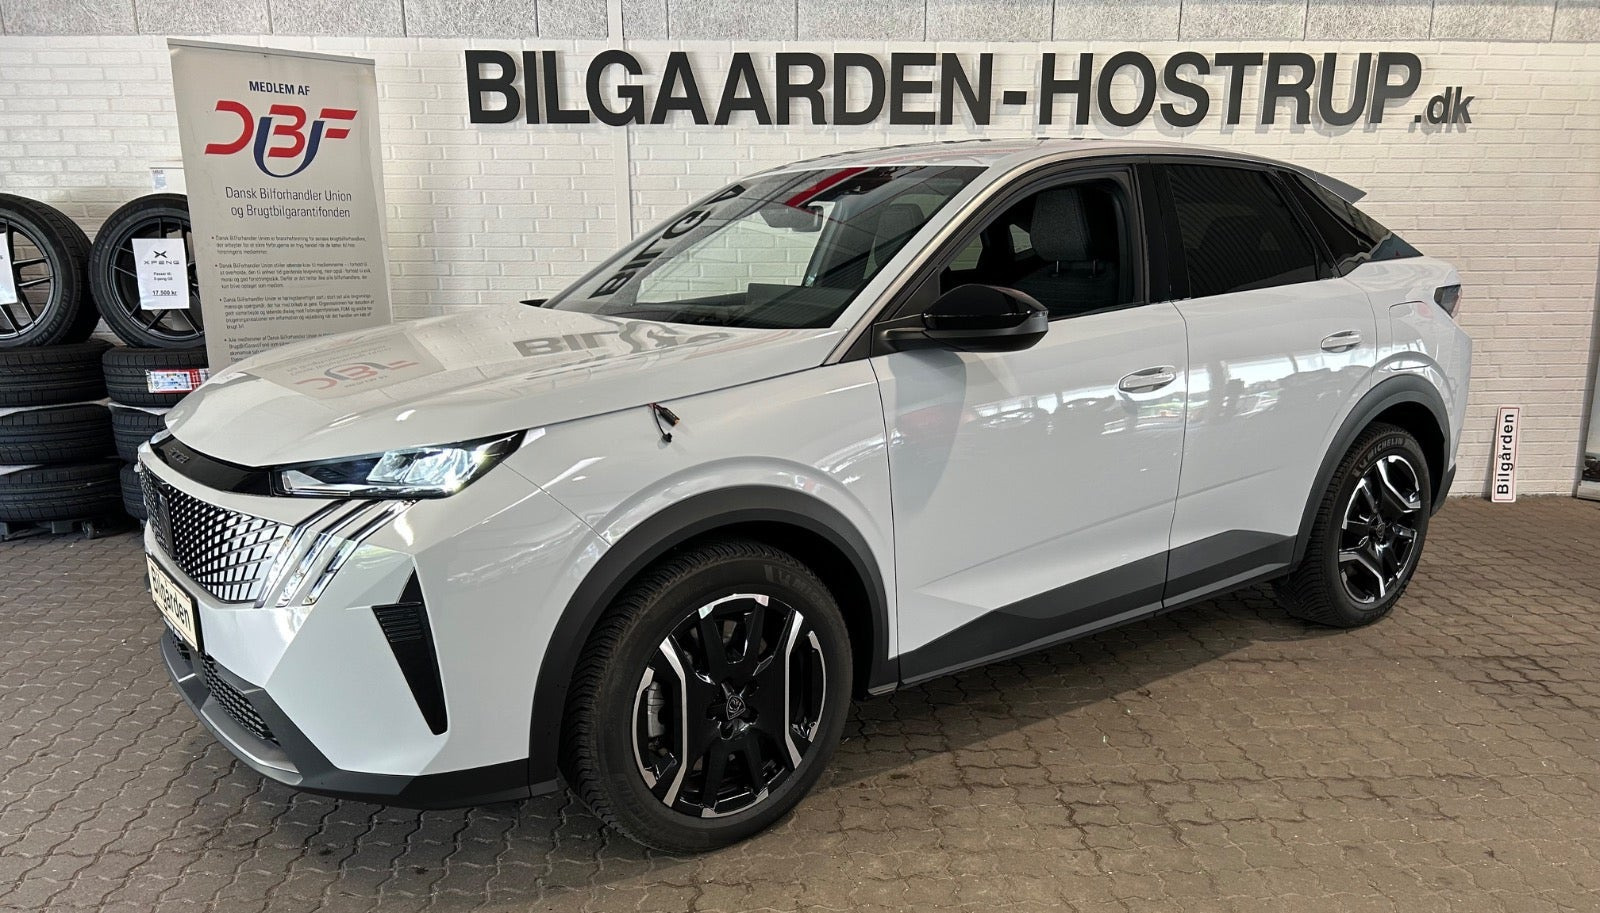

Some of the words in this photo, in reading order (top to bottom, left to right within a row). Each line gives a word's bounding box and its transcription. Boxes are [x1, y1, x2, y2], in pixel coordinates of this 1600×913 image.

[249, 81, 295, 95] MEDLEM
[297, 85, 311, 96] AF
[225, 187, 257, 199] Dansk
[259, 188, 322, 201] Bilforhandler
[324, 191, 352, 202] Union
[231, 207, 244, 218] og
[246, 206, 351, 219] Brugtbilgarantifonden
[1367, 437, 1405, 461] MICHELIN
[1497, 414, 1515, 494] Bilgården
